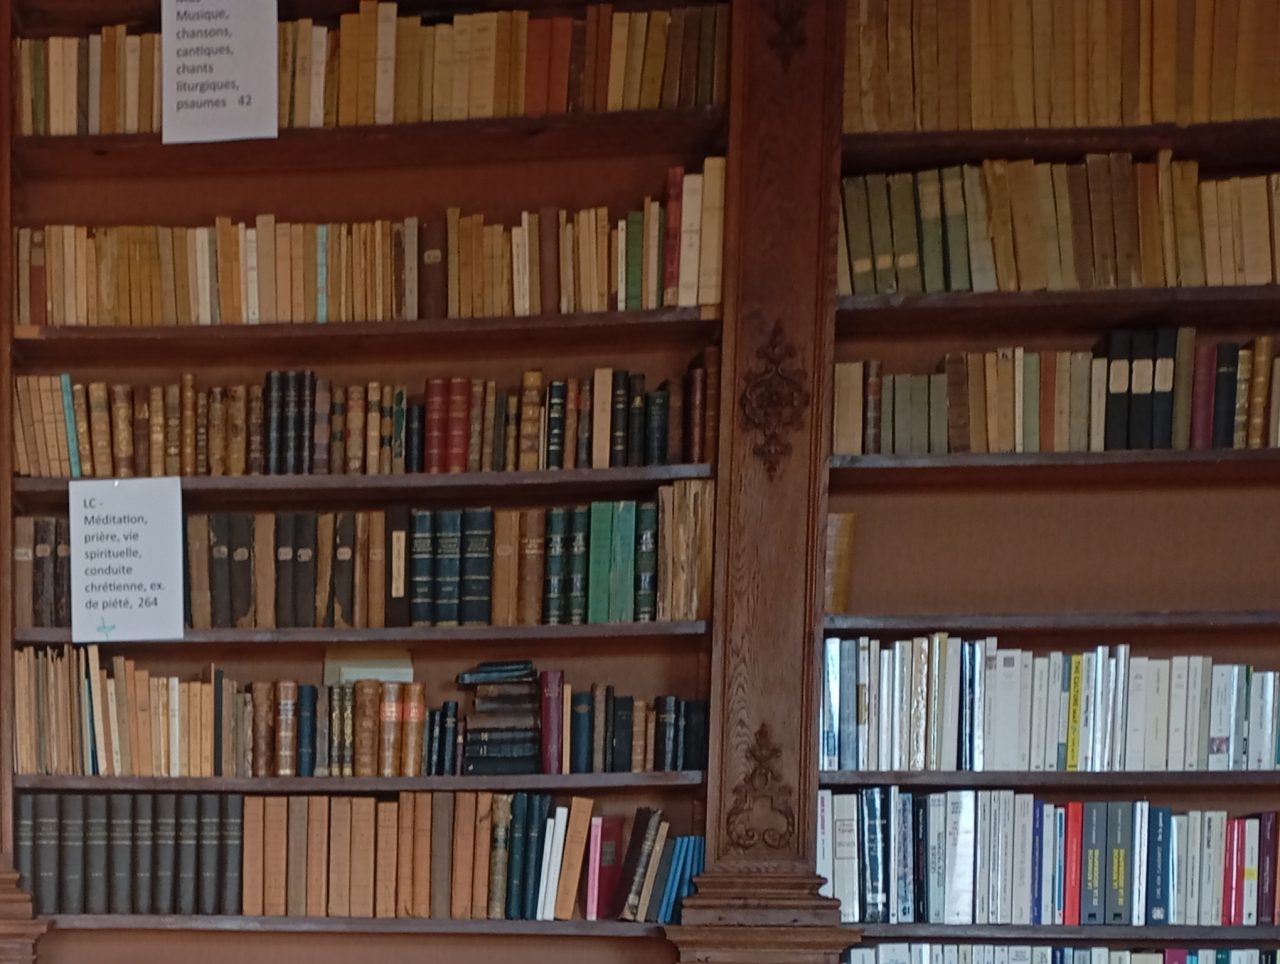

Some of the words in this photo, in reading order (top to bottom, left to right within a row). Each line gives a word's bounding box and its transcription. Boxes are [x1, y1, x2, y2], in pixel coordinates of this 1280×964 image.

[176, 9, 229, 21] Musique,
[176, 27, 232, 40] chansons,
[176, 45, 234, 58] cantiques,
[176, 63, 214, 75] chants
[176, 80, 239, 94] liturgiques,
[176, 98, 227, 111] psaumes
[238, 94, 252, 106] 42
[84, 514, 148, 526] Méditation,
[84, 532, 120, 544] prière,
[122, 531, 140, 542] vie
[84, 548, 142, 561] spirituelle,
[84, 565, 133, 576] conduite
[85, 581, 147, 593] chrétienne,
[149, 582, 166, 591] ex.
[85, 599, 99, 610] de
[102, 598, 133, 611] piété,
[138, 597, 158, 608] 264
